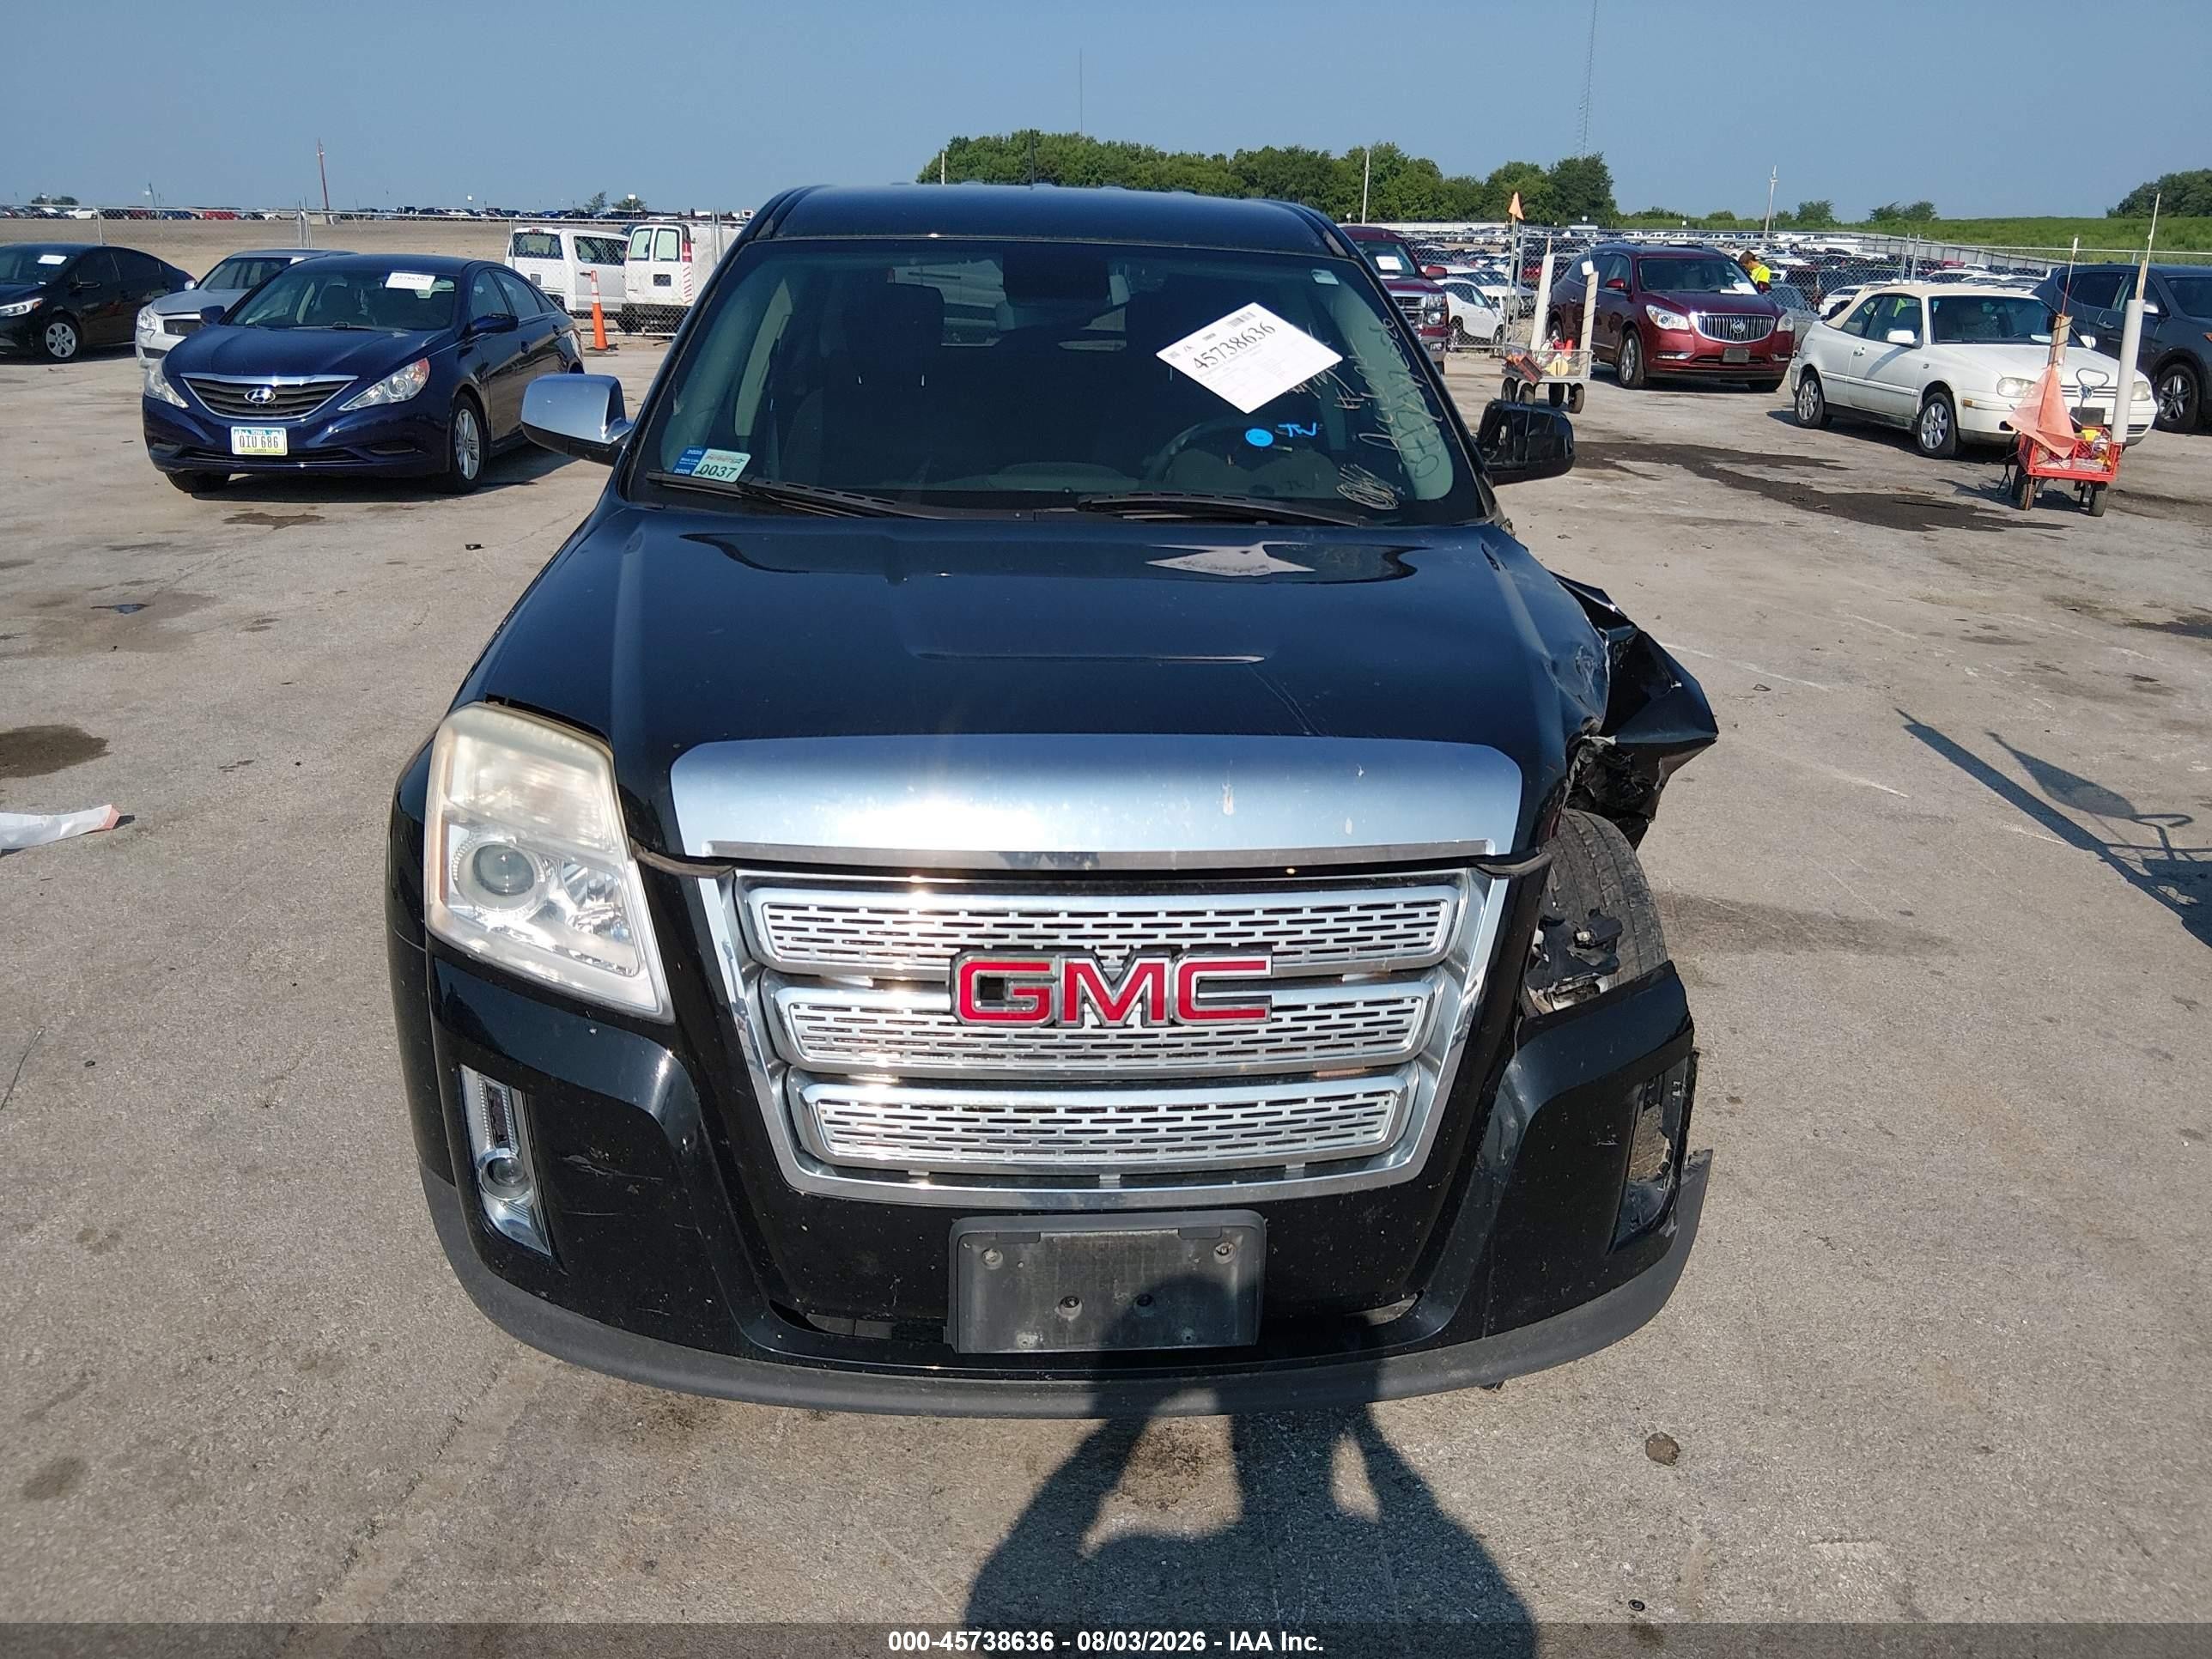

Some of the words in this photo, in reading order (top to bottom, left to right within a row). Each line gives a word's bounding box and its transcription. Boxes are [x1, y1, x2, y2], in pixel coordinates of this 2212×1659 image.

[1193, 322, 1276, 369] 45738636
[260, 435, 279, 449] 686
[699, 464, 738, 478] 0037
[951, 950, 1273, 1026] GMC
